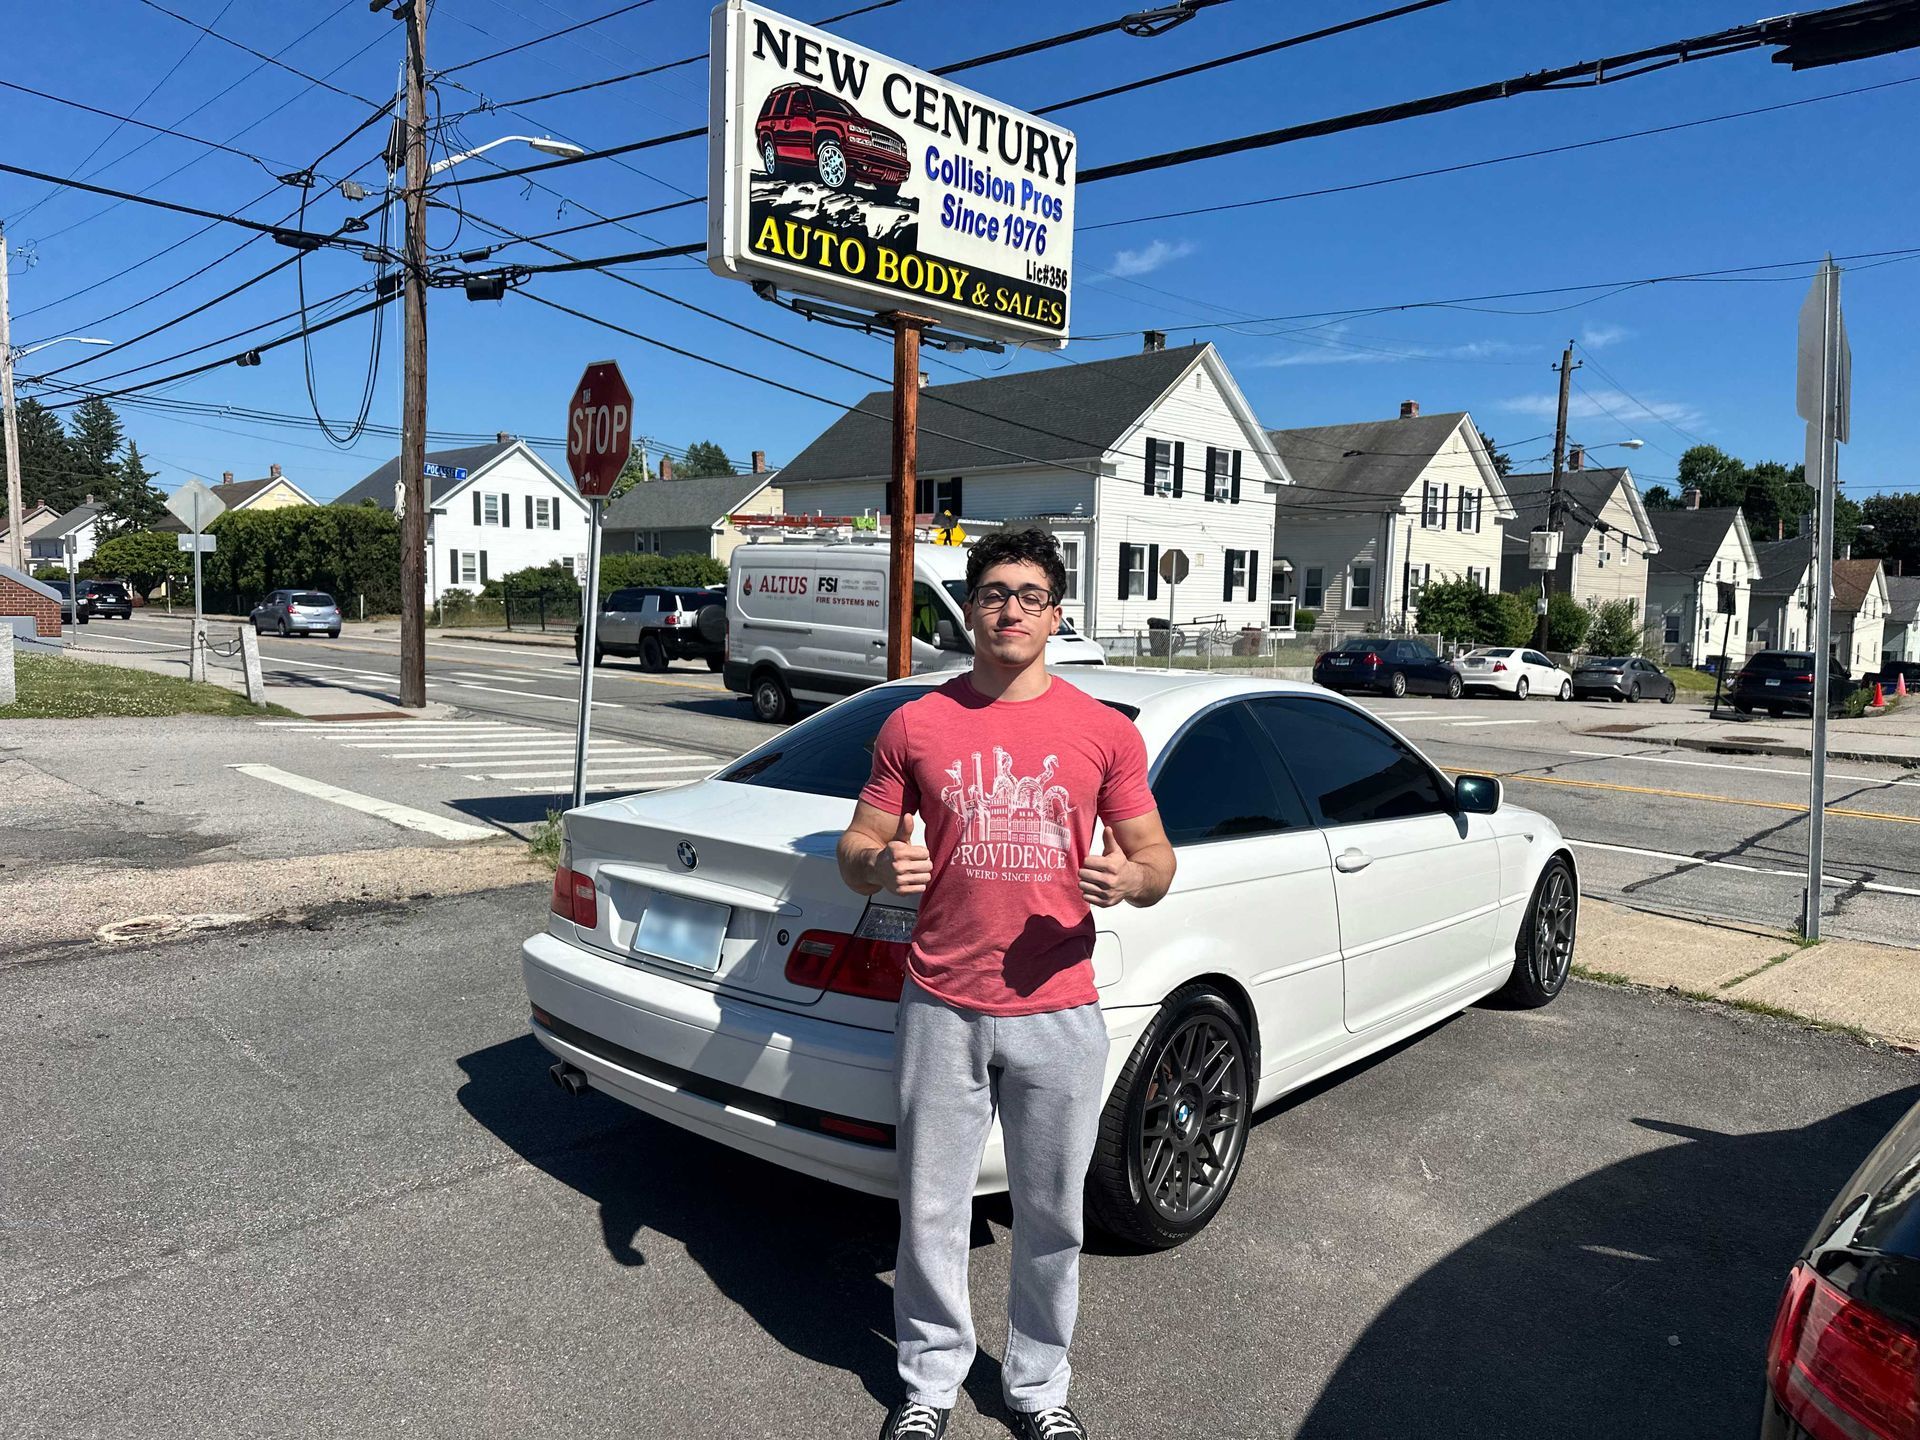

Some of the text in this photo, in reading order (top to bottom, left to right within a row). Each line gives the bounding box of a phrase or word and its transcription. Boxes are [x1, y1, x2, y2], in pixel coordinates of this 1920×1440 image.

[752, 18, 1074, 186] NEW CENTURY
[925, 145, 1063, 222] Collision Pros
[940, 193, 1047, 256] Since 1976
[755, 216, 1063, 325] AUTO BODY & SALES
[1026, 259, 1068, 290] Lic#356
[571, 404, 627, 455] STOP
[759, 575, 808, 595] ALTUS
[818, 577, 838, 592] FSI
[815, 596, 880, 607] FIRE SYSTEMS INC
[950, 843, 1067, 869] PROVIDENCE
[966, 868, 998, 880] WEIRD
[1001, 871, 1030, 882] SINCE
